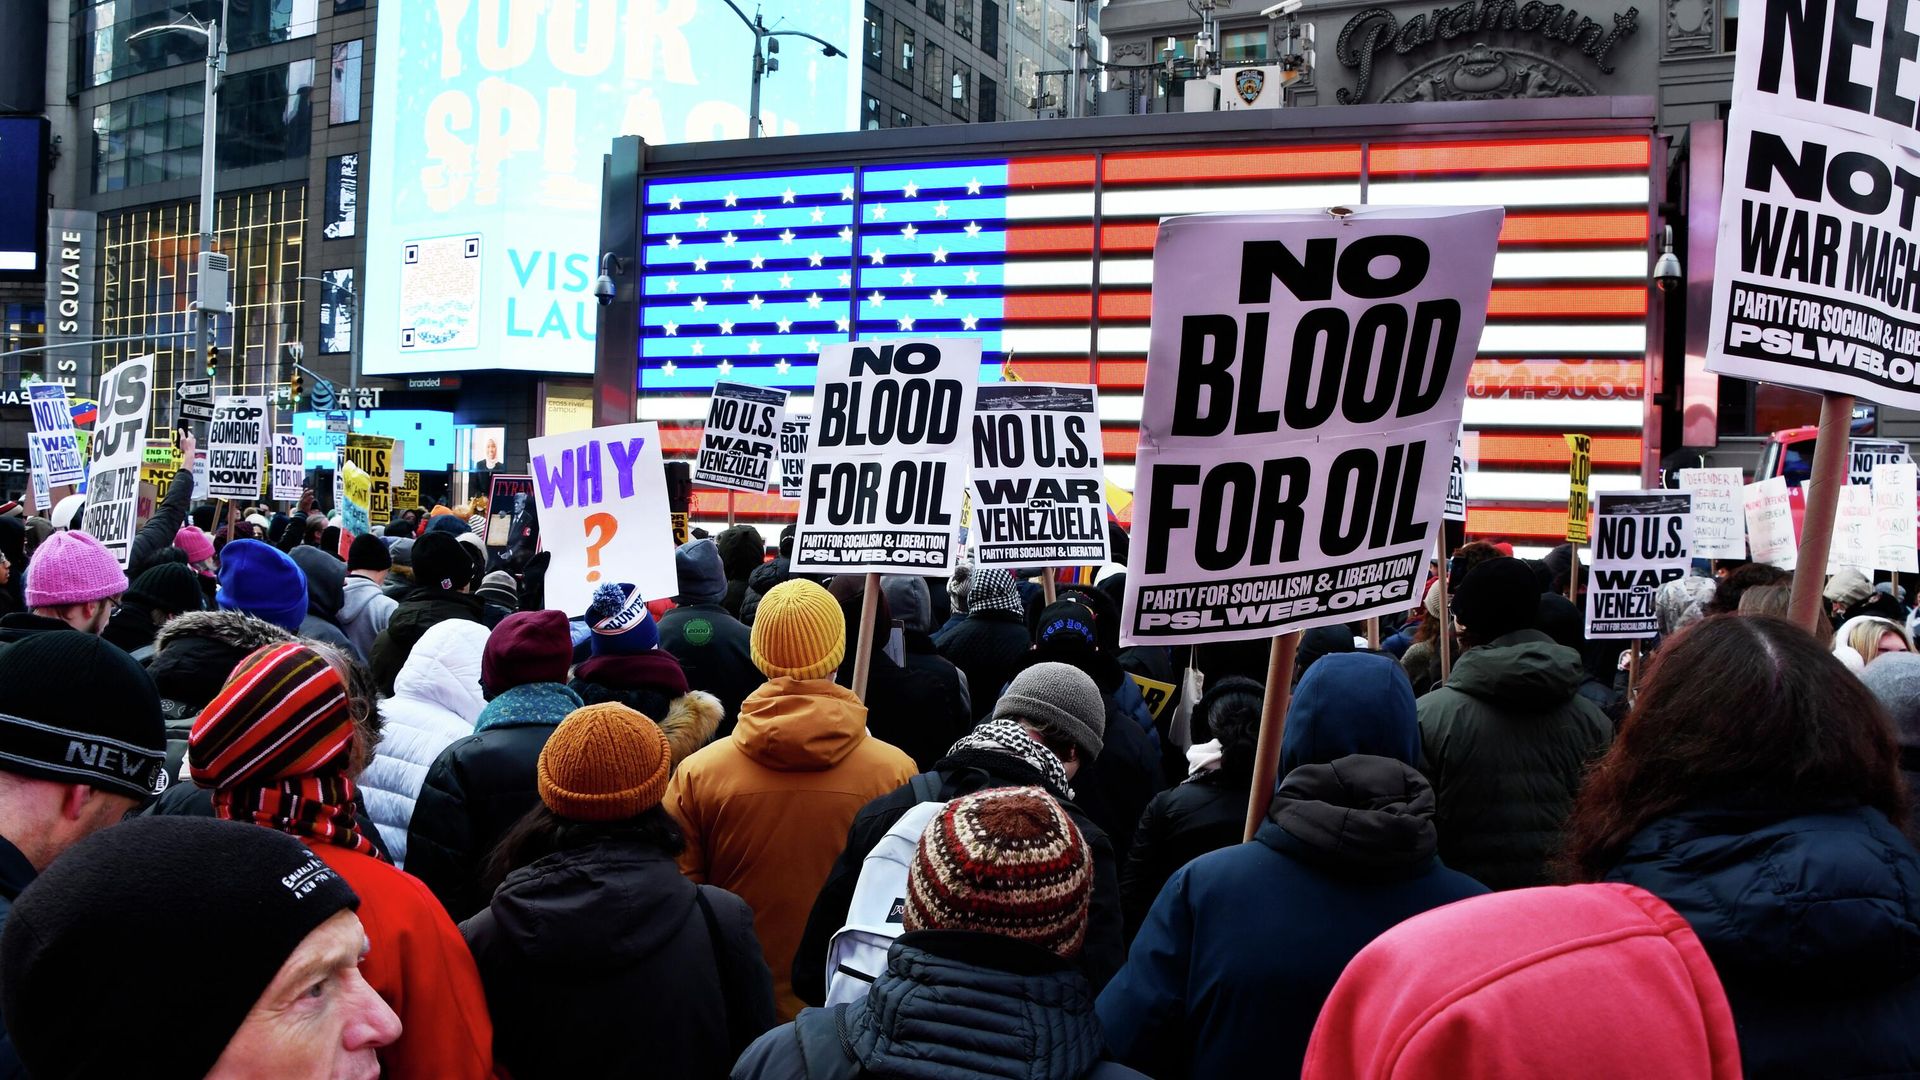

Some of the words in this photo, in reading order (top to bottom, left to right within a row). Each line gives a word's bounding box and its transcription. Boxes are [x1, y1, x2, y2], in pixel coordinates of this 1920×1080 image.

[431, 0, 699, 86] YOUR
[1335, 0, 1639, 104] Paramount
[1757, 0, 1920, 131] NEE
[1741, 198, 1841, 288] WAR
[59, 231, 81, 333] SQUARE
[507, 249, 598, 290] VIS
[1238, 235, 1430, 304] NO
[1733, 288, 1788, 323] PARTY
[1788, 298, 1820, 330] FOR
[1821, 305, 1882, 344] SOCIALISM
[1882, 325, 1894, 350] &
[849, 343, 941, 377] NO
[1171, 299, 1461, 437] BLOOD
[100, 364, 147, 423] US
[339, 387, 384, 408] A&T
[409, 377, 440, 388] branded
[34, 401, 54, 431] NO
[187, 405, 201, 414] ONE
[215, 407, 262, 420] STOP
[708, 398, 738, 431] NO
[738, 402, 777, 439] U.S.
[818, 378, 962, 447] BLOOD
[41, 436, 76, 451] WAR
[94, 419, 142, 462] OUT
[210, 422, 259, 445] BOMBING
[282, 436, 297, 446] NO
[308, 436, 322, 445] our
[325, 434, 346, 445] bes
[781, 422, 810, 433] ST
[972, 414, 1025, 468] NO
[1031, 414, 1097, 468] U.S.
[209, 450, 257, 470] VENEZUELA
[276, 446, 302, 465] BLOOD
[705, 434, 773, 459] WAR
[1853, 453, 1872, 472] NO
[209, 471, 257, 484] NOW!
[275, 469, 294, 487] FOR
[533, 438, 645, 509] WHY
[699, 450, 768, 480] VENEZUELA
[117, 466, 137, 500] THE
[805, 462, 882, 525] FOR
[886, 460, 951, 525] OIL
[974, 479, 1100, 504] WAR
[977, 507, 1103, 542] VENEZUELA
[1145, 456, 1311, 575] FOR
[1319, 440, 1428, 559] OIL
[584, 512, 618, 582] ?
[802, 534, 827, 549] PARTY
[828, 535, 843, 548] FOR
[844, 533, 882, 548] SOCIALISM
[883, 534, 894, 548] &
[896, 534, 945, 549] LIBERATION
[982, 548, 1004, 560] PARTY
[1005, 547, 1019, 559] FOR
[1019, 547, 1056, 558] SOCIALISM
[1057, 547, 1066, 557] &
[1067, 546, 1102, 558] LIBERATION
[1597, 517, 1636, 560] NO
[1641, 516, 1687, 559] U.S.
[801, 549, 944, 564] PSLWEB.ORG
[1142, 587, 1196, 610] PARTY
[1197, 584, 1229, 606] FOR
[1230, 575, 1312, 604] SOCIALISM
[1315, 573, 1333, 592] &
[1336, 555, 1416, 589] LIBERATION
[1139, 580, 1408, 631] PSLWEB.ORG
[1592, 623, 1609, 631] PARTY
[1610, 623, 1620, 631] FOR
[1620, 622, 1646, 631] SOCIALISM
[65, 741, 146, 776] NEW
